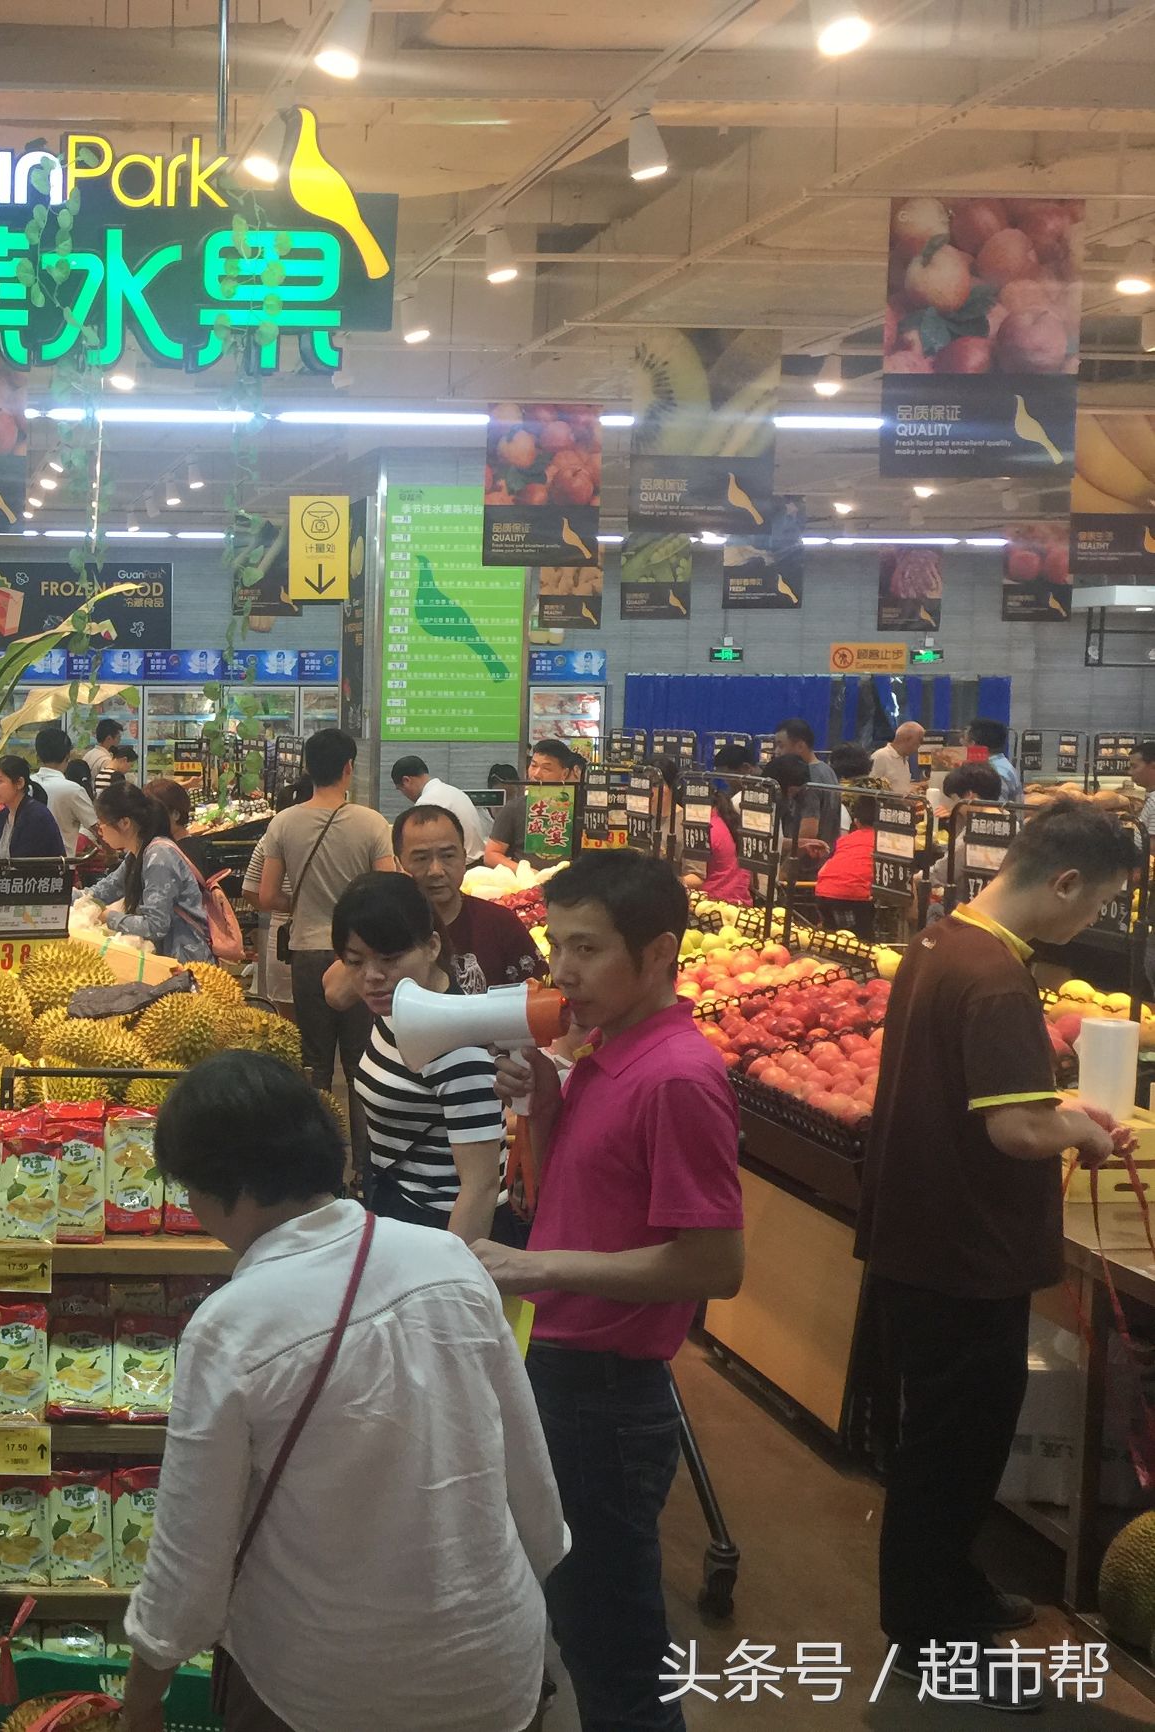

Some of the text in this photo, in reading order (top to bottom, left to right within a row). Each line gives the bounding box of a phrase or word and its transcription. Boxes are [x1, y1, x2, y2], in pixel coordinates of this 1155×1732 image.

[897, 405, 961, 420] 品质保证
[896, 423, 952, 436] QUALITY
[639, 478, 687, 491] 品质保证
[639, 492, 681, 502] QUALITY
[305, 543, 336, 553] 计量处
[118, 570, 164, 579] GuanPark
[879, 808, 912, 825] 商品价格牌
[970, 818, 1011, 836] 商品价格牌
